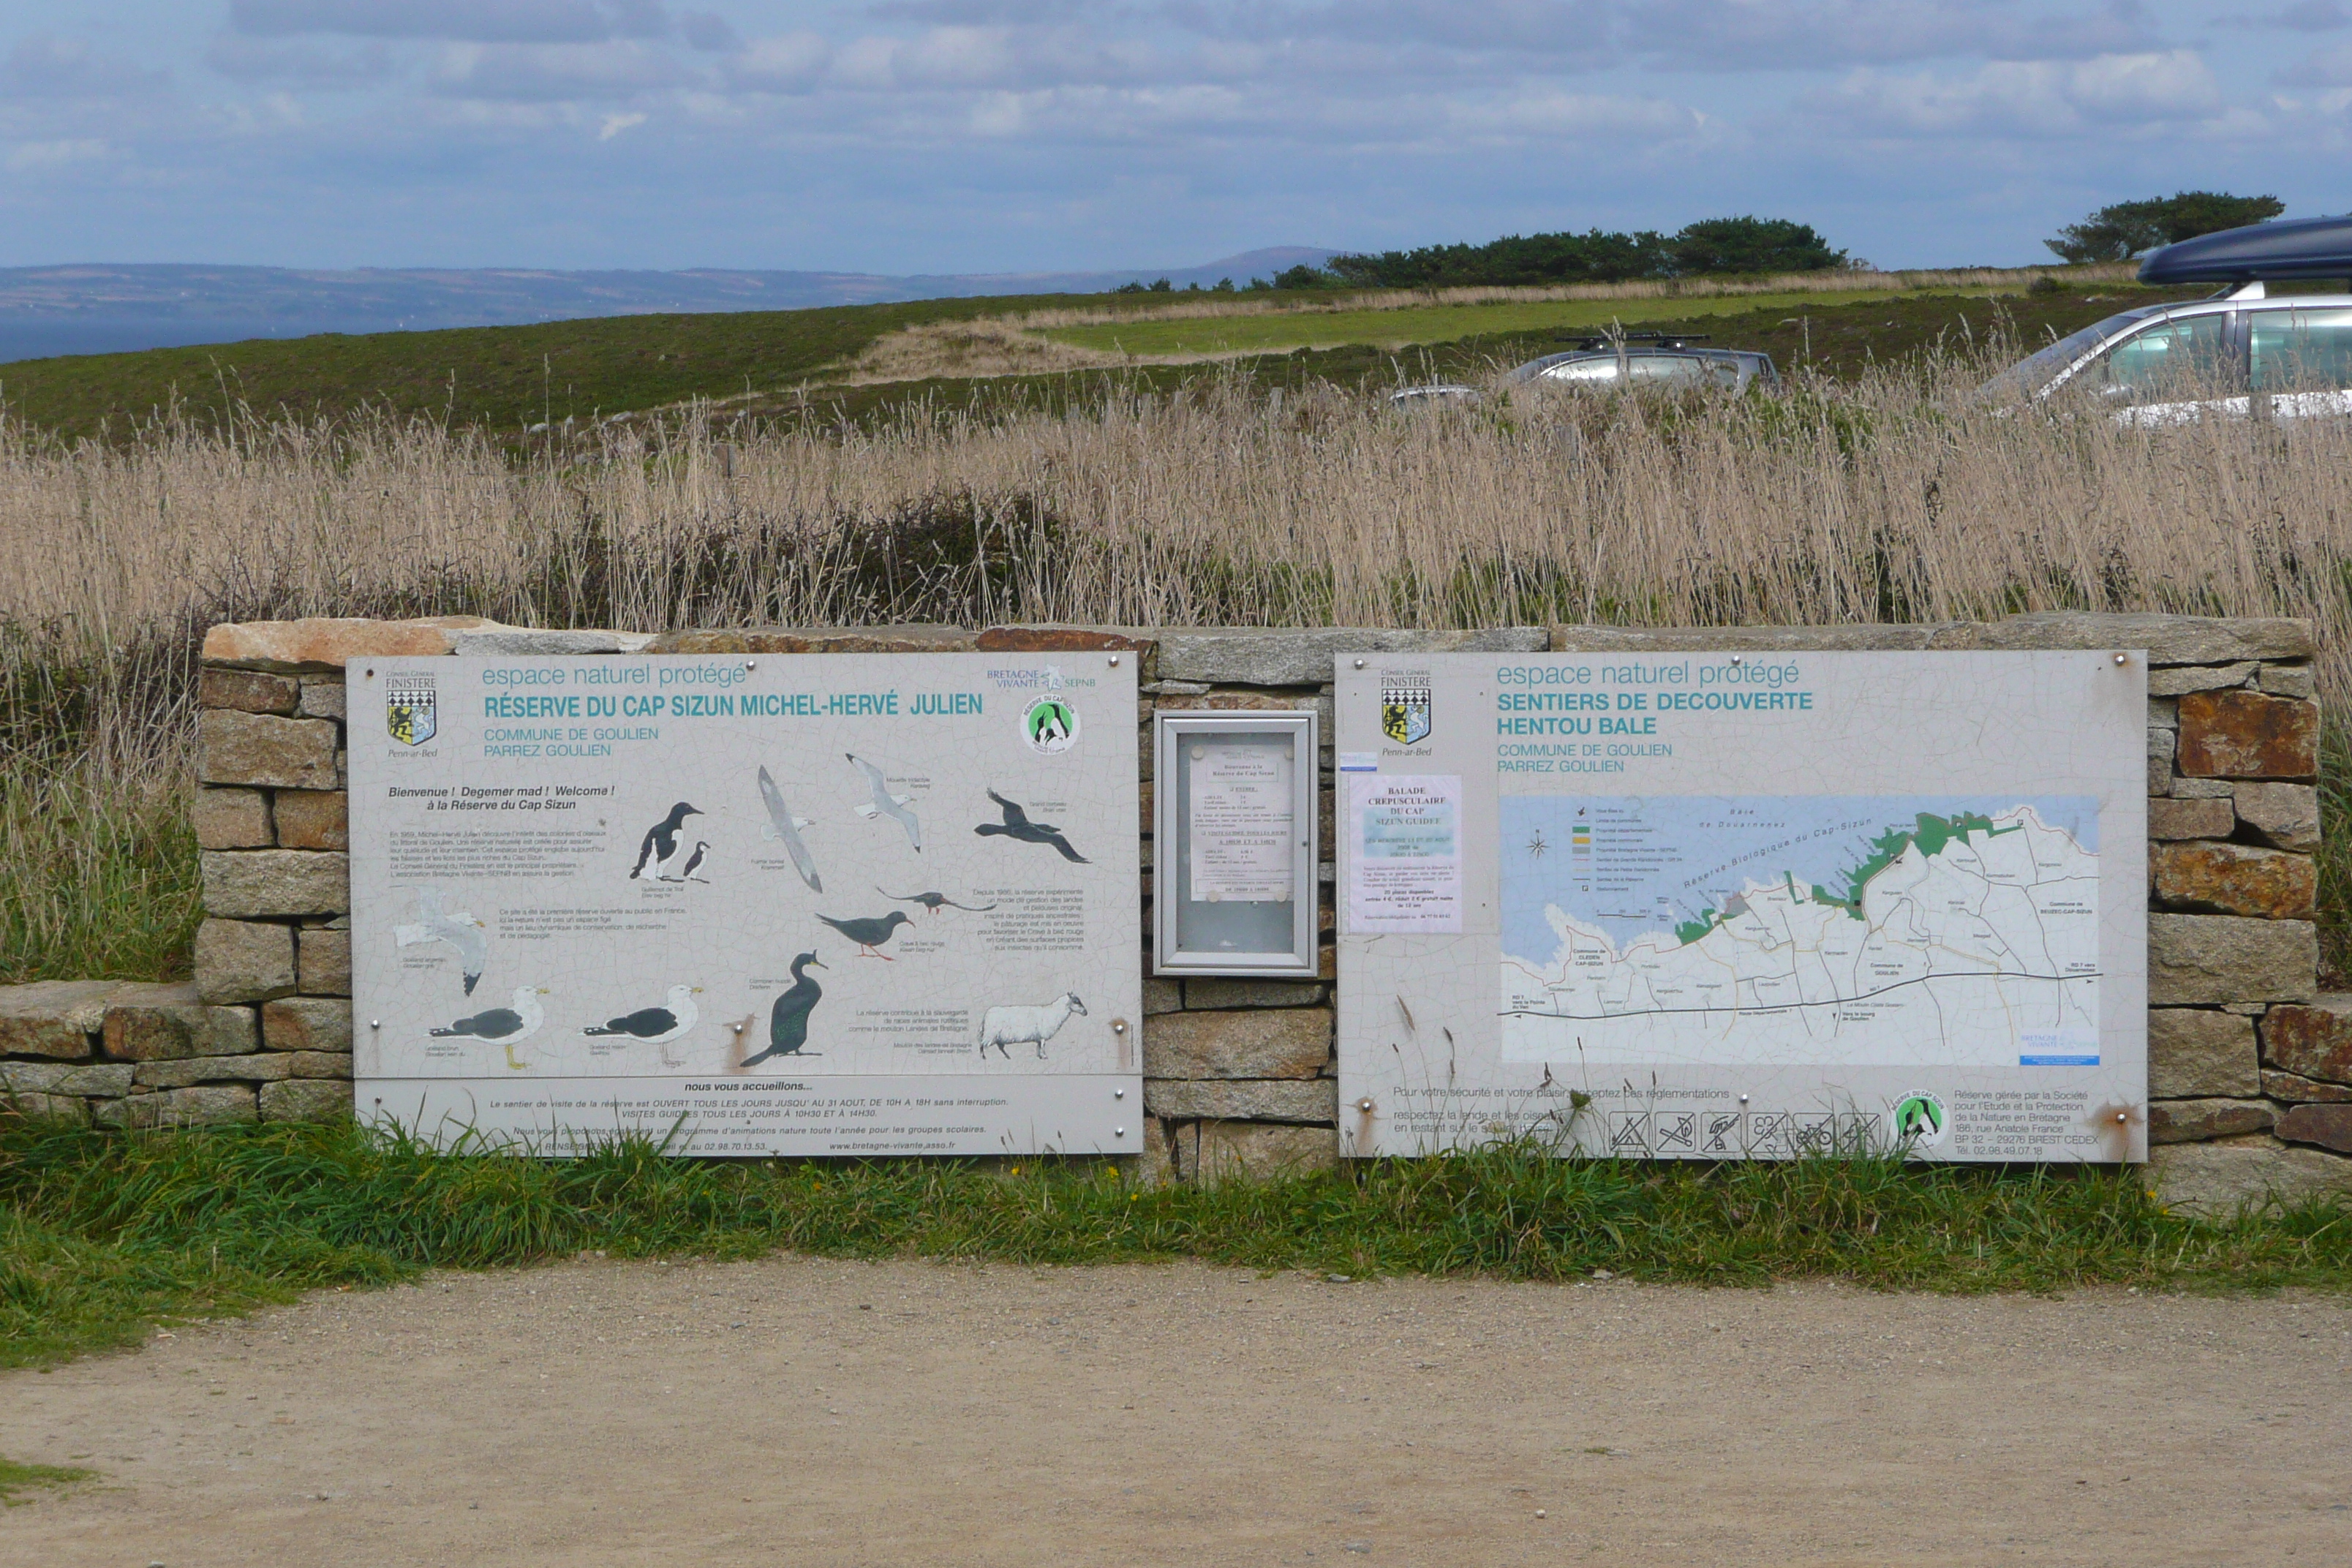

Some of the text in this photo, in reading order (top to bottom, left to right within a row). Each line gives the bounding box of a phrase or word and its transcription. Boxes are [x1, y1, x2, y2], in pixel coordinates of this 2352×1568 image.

[483, 663, 745, 689] espace naturel protégé
[987, 670, 1039, 679] BRETAGNE
[1497, 660, 1798, 689] espace naturel protégé
[997, 679, 1039, 687] VIVANTE
[485, 690, 982, 717] RÉSERVE DU CAP SIZUN MICHEL-HERVÉ JULIEN
[1498, 693, 1812, 710] SENTIERS DE DECOUVERTE
[1498, 717, 1656, 735] HENTOU BALE
[484, 728, 658, 741] COMMUNE DE GOULIEN
[388, 749, 437, 757] Penn-ar-Bed
[484, 745, 611, 756] PARREZ GOULIEN
[1499, 744, 1672, 756] COMMUNE DE GOULIEN
[1498, 761, 1624, 772] PARREZ GOULIEN
[388, 786, 607, 799] Bienvenue Degemer mad Welcome
[427, 799, 576, 811] à la Réserve du Cap Sizun
[1684, 818, 1872, 889] Réserve Biologique du Cap-Sizun
[685, 1082, 711, 1091] nous
[715, 1083, 739, 1091] vous
[1394, 1087, 1417, 1097] Pour
[1421, 1088, 1446, 1097] votre
[1451, 1087, 1490, 1097] sécurité
[1494, 1088, 1504, 1097] et
[1507, 1088, 1532, 1097] votre
[1955, 1090, 1992, 1099] Réserve
[1996, 1091, 2021, 1101] gérée
[2043, 1091, 2050, 1099] la
[2054, 1091, 2088, 1099] Société
[957, 1098, 1008, 1107] interruption.
[1979, 1102, 2010, 1110] l'Etude
[2026, 1102, 2032, 1110] la
[2037, 1102, 2084, 1111] Protection
[1394, 1109, 1519, 1121] respectez la lande et les
[1980, 1113, 2010, 1121] Nature
[2029, 1113, 2070, 1123] Bretagne
[1411, 1124, 1445, 1132] restant
[1469, 1123, 1479, 1132] le
[1994, 1124, 2029, 1132] Anatole
[2032, 1125, 2063, 1133] France
[1955, 1135, 2099, 1145] BP 32 29276 BREST CEDEX
[829, 1142, 955, 1150] www.bretagne-vivante.asso.fr
[1956, 1146, 1970, 1154] Tél.
